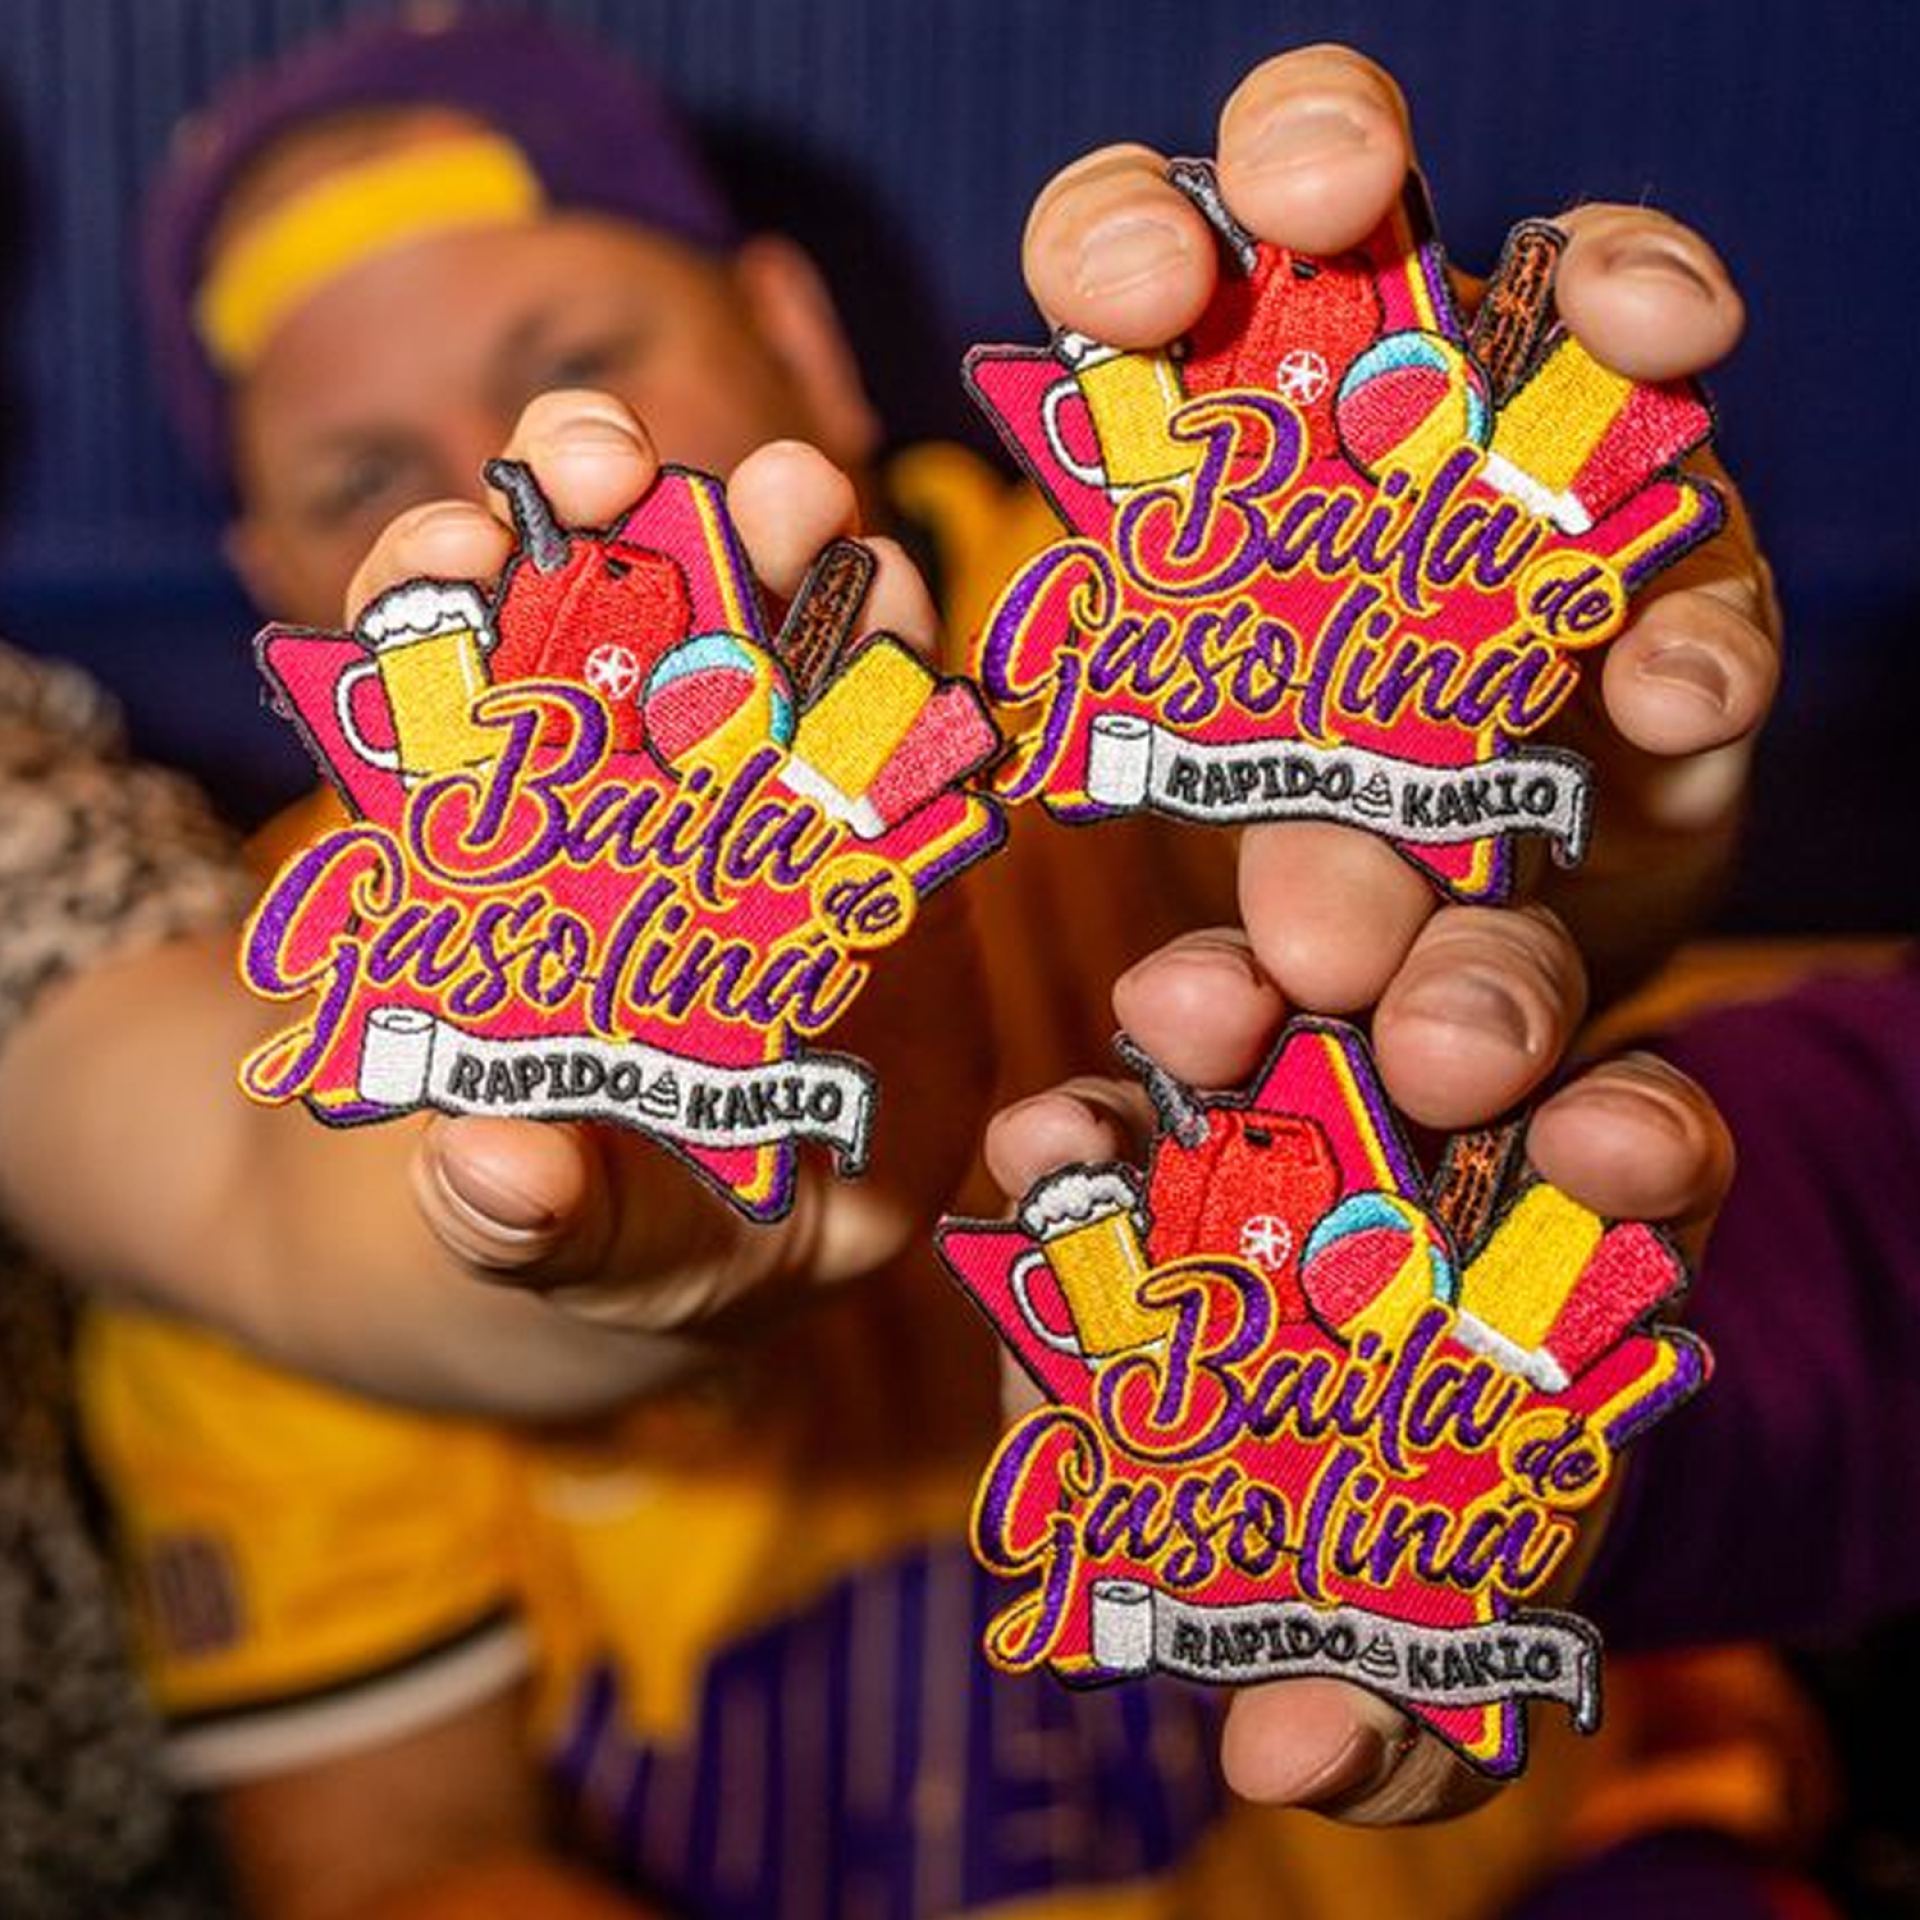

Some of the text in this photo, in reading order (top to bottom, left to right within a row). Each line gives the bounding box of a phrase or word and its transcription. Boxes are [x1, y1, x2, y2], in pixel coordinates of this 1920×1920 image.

[1114, 388, 1614, 639] Baila de
[980, 536, 1581, 805] Gasolina
[1165, 758, 1558, 829] RAPIDO KAKIO
[406, 678, 902, 938] Baila de
[241, 821, 868, 1106] Gasolina
[446, 1051, 841, 1130] RAPIDO KAKIO
[1096, 1255, 1599, 1495] Baila de
[972, 1404, 1575, 1672] Gasolina
[1170, 1620, 1561, 1689] RAPIDO KAKIO
